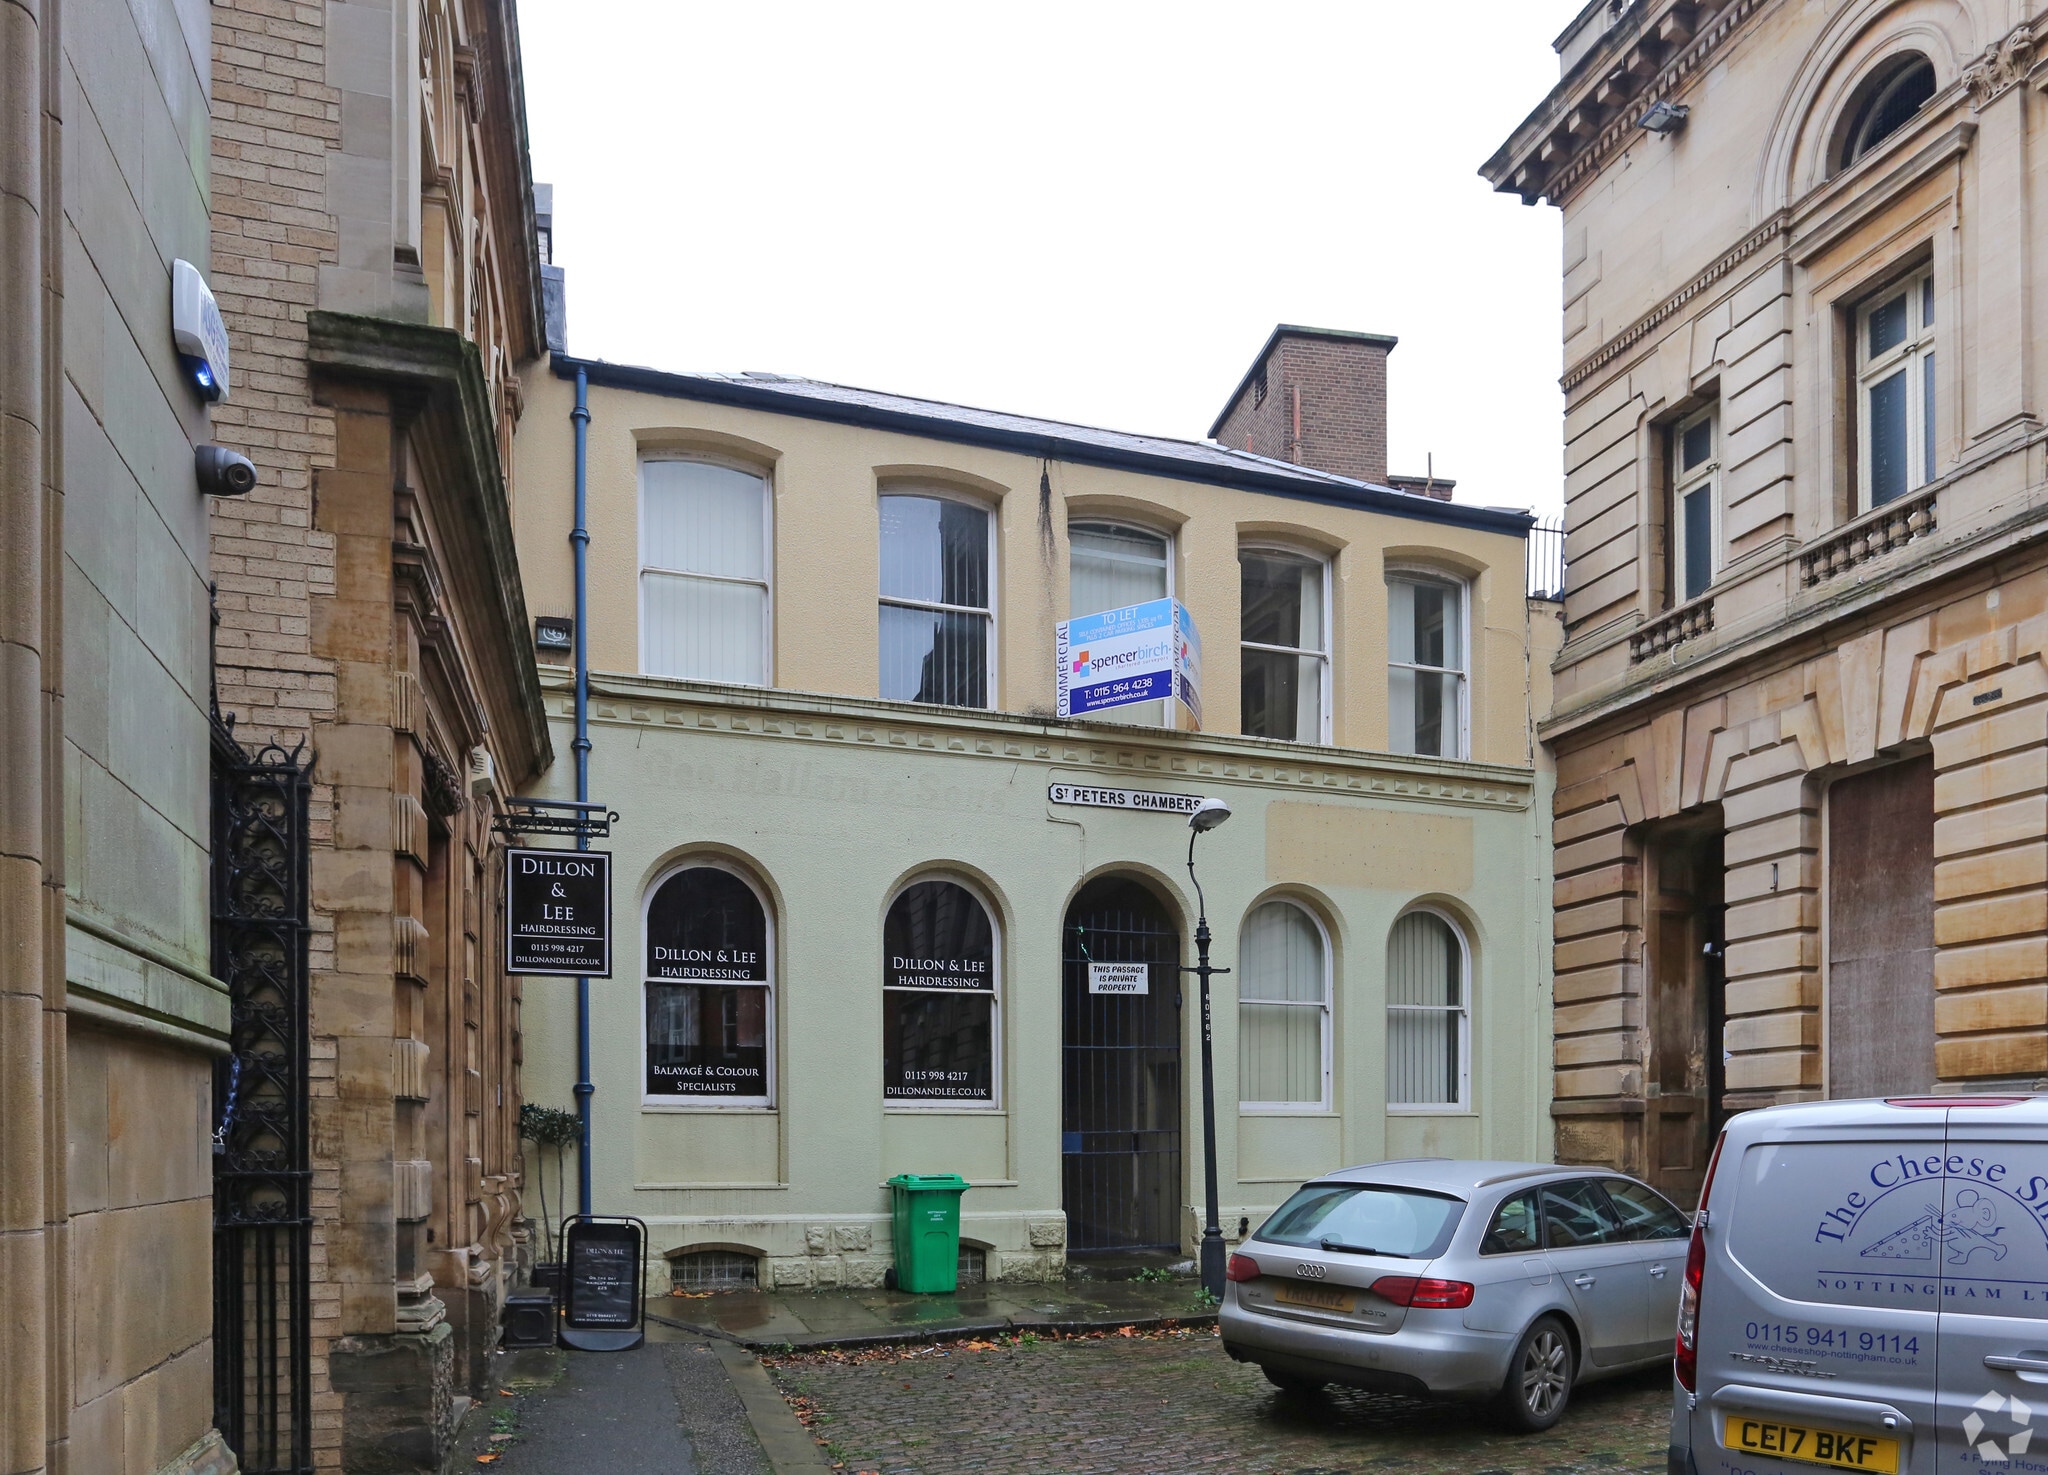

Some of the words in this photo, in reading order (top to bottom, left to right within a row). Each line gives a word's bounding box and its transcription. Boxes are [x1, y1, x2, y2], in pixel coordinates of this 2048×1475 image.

[1102, 612, 1116, 626] TO
[1120, 607, 1138, 622] LET
[1091, 641, 1168, 672] spencerbirch
[1058, 622, 1068, 717] COMMERCIAL
[1084, 690, 1092, 700] T:
[1094, 686, 1110, 698] 0115
[1113, 682, 1130, 694] 964
[1132, 678, 1153, 690] 4238
[1086, 690, 1149, 707] www.spencerbirch.co.uk
[1074, 789, 1126, 804] PETERS
[1133, 794, 1202, 811] CHAMBERS
[521, 858, 595, 877] DILLON
[551, 882, 567, 898] &
[543, 904, 574, 920] LEE
[520, 924, 596, 936] HAIRDRESSING
[530, 943, 549, 952] 0115
[551, 944, 565, 952] 998
[566, 945, 584, 953] 4217
[654, 946, 712, 962] DILLON
[716, 950, 729, 962] &
[733, 950, 757, 964] LEE
[516, 955, 600, 966] DILLONANDLEE.CO.UK
[893, 956, 944, 971] DILLON
[949, 960, 960, 972] &
[964, 960, 985, 973] LEE
[661, 966, 750, 980] HAIRDRESSING
[1112, 966, 1144, 974] PASSAGE
[898, 976, 980, 988] HAIRDRESSING
[1098, 984, 1136, 992] PROPERTY
[654, 1064, 702, 1076] BALAYAGÉ
[705, 1066, 714, 1076] &
[716, 1066, 760, 1077] COLOUR
[905, 1070, 926, 1080] 0115
[928, 1071, 945, 1080] 998
[946, 1072, 968, 1080] 4217
[676, 1082, 736, 1092] SPECIALISTS
[886, 1086, 986, 1096] DILLONANDLEE.CO.UK
[1815, 1190, 1866, 1244] The
[1870, 1154, 2007, 1188] Cheese
[1817, 1278, 2001, 1299] NOTTINGHAM
[1745, 1322, 1798, 1344] 0115
[1806, 1327, 1848, 1348] 941
[1859, 1332, 1920, 1355] 9114
[1747, 1342, 1918, 1366] www.cheeseshop-nottingham.co.uk
[1742, 1421, 1806, 1454] CE17
[1814, 1432, 1878, 1465] BKF
[1960, 1452, 1968, 1461] 4
